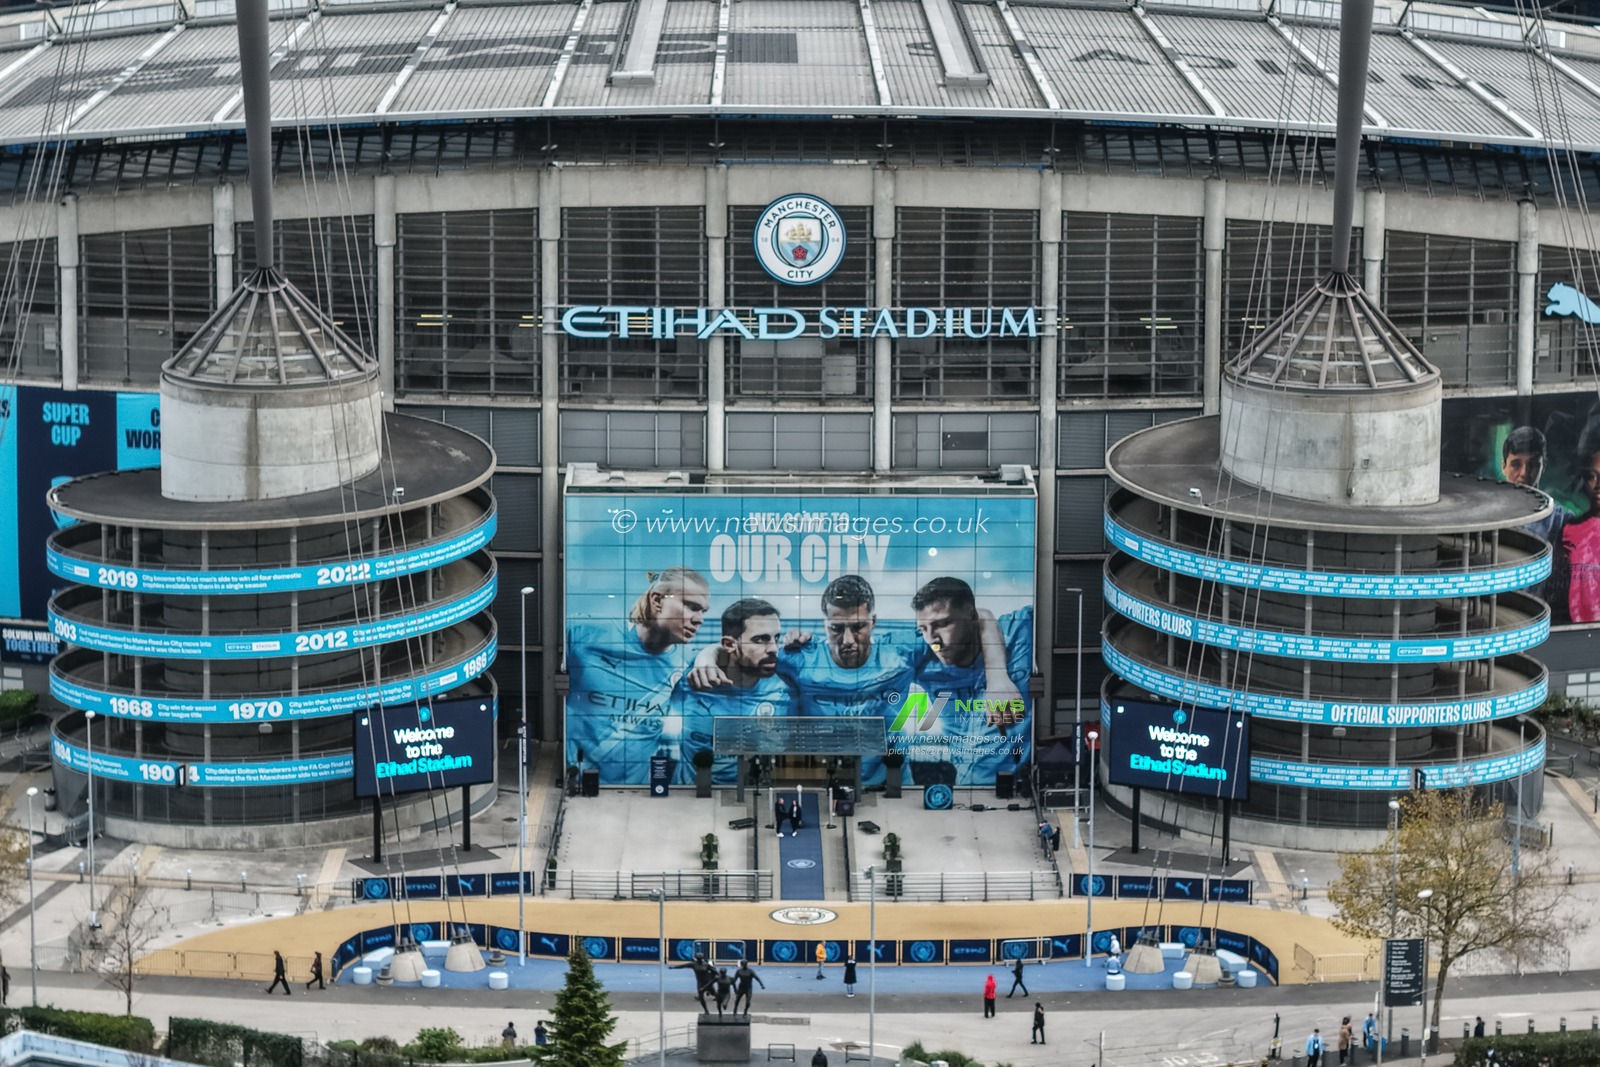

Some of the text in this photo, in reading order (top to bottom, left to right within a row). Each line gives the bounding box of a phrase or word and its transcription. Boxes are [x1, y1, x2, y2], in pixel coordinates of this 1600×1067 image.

[764, 201, 836, 229] MANCHESTER
[787, 270, 813, 279] CITY
[561, 305, 1037, 341] ETIHAD STADIUM
[42, 401, 90, 426] SUPER
[51, 425, 81, 447] CUP
[125, 429, 161, 449] WOR
[749, 512, 829, 534] WELCOME
[709, 533, 891, 585] OUR CITY
[98, 567, 138, 589] 2019
[317, 562, 371, 585] 2022
[1117, 589, 1160, 628] SUPPORTERS
[1161, 611, 1193, 638] CLUBS
[2, 628, 33, 641] SOLVING
[54, 618, 77, 641] 2003
[6, 639, 59, 655] TOGETHER
[295, 630, 348, 653] 2012
[109, 696, 153, 718] 1968
[229, 701, 283, 720] 1970
[1331, 701, 1492, 725] OFFICIAL SUPPORTERS CLUBS
[394, 725, 455, 744] Welcome
[1148, 725, 1210, 747] Welcome
[405, 741, 443, 759] to the
[1160, 743, 1198, 761] to the
[376, 754, 473, 778] Etihad Stadium
[1129, 753, 1172, 774] Etihad
[1172, 759, 1227, 781] Stadium
